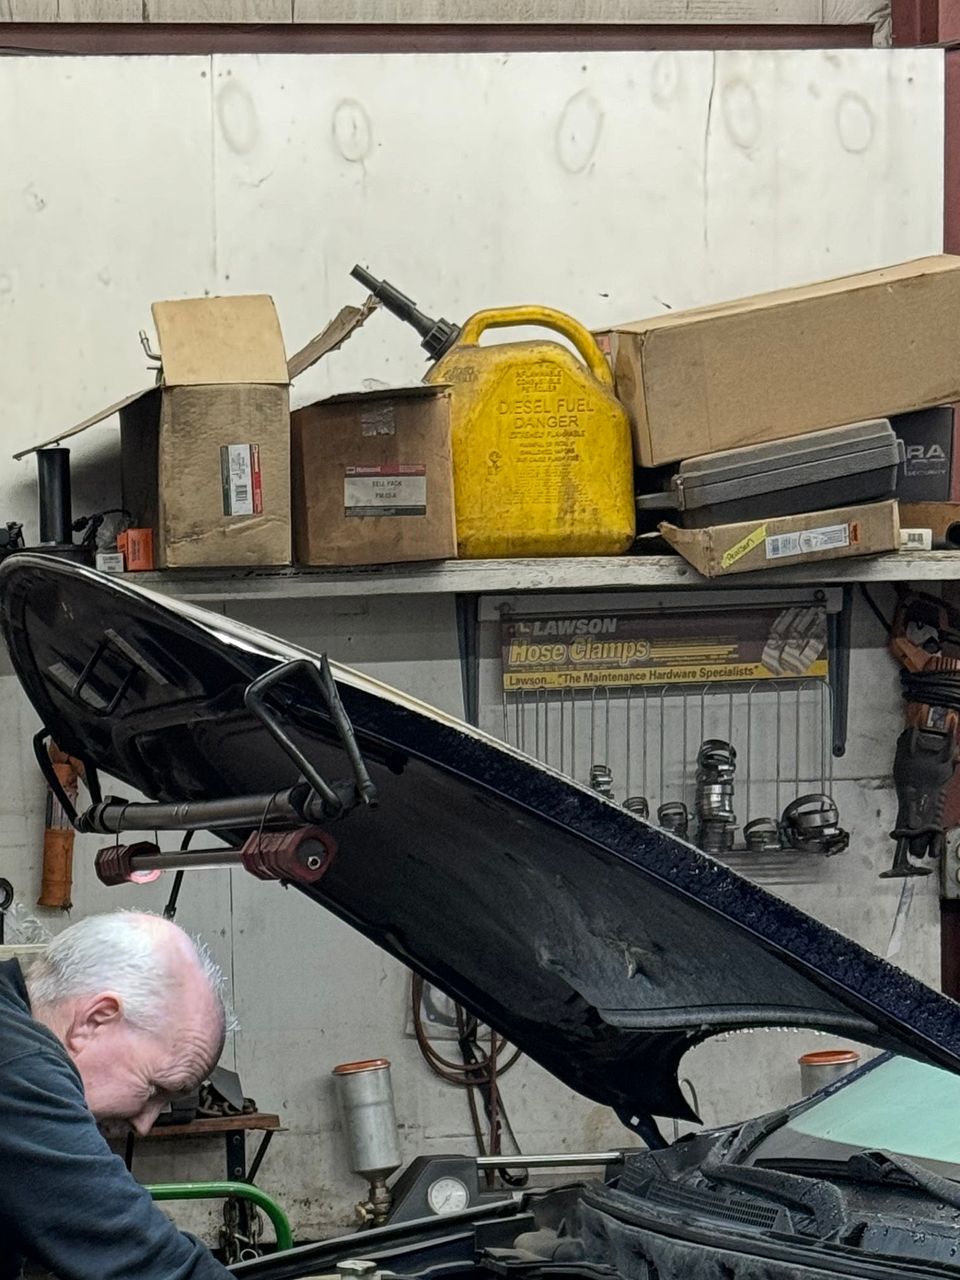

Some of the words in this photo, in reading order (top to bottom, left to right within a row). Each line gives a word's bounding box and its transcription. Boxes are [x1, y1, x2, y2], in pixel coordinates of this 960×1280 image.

[498, 399, 552, 415] DIESEL
[557, 398, 594, 413] FUEL
[514, 415, 579, 429] DANGER
[533, 618, 617, 636] LAWSON
[509, 637, 567, 665] Hose
[569, 634, 651, 666] Clamps
[583, 671, 647, 684] Maintenance
[649, 669, 697, 681] Hardware
